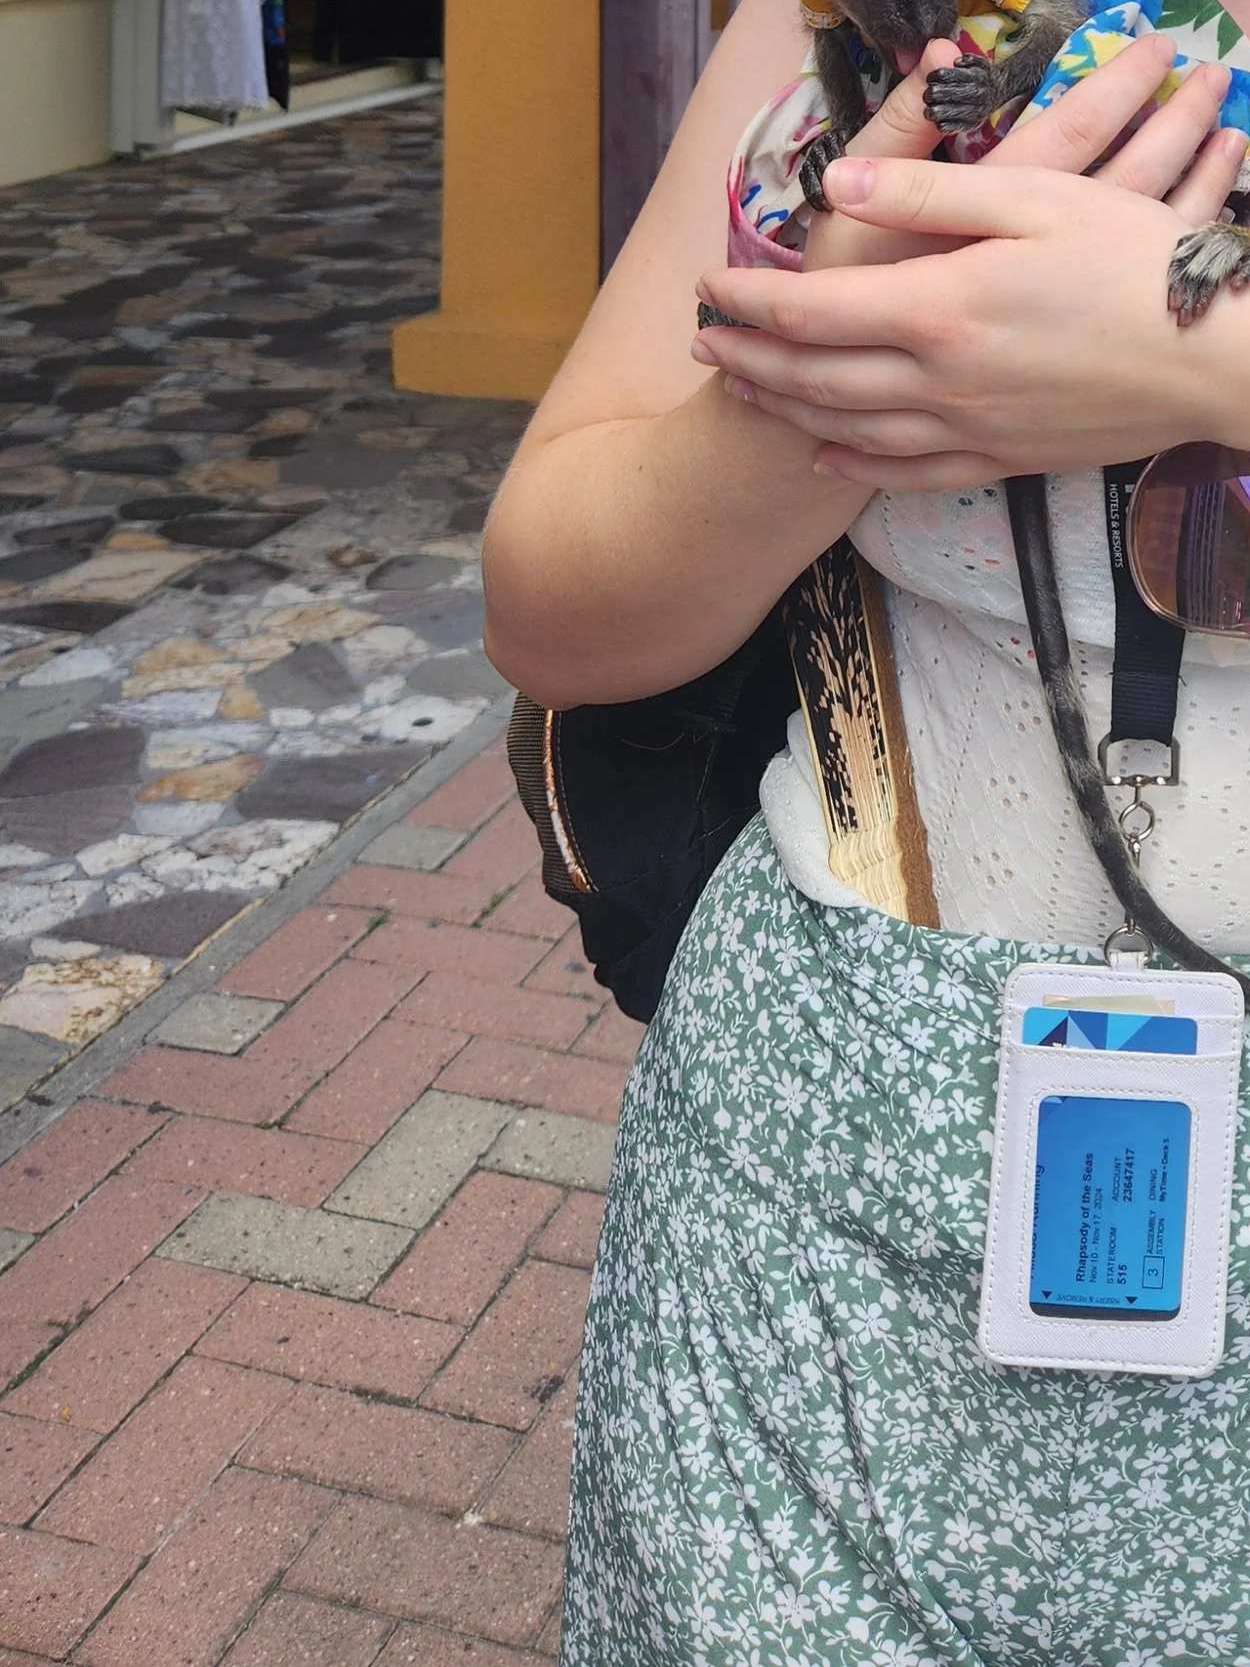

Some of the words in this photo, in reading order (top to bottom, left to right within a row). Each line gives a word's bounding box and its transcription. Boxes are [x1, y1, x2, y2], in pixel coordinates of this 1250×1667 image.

[1109, 483, 1120, 520] HOTELS
[1111, 520, 1120, 529] &
[1112, 529, 1124, 569] RESORTS
[1083, 1153, 1094, 1182] Seas
[1082, 1186, 1091, 1203] the
[1149, 1168, 1158, 1201] DINING
[1159, 1170, 1168, 1202] MyTime
[1082, 1205, 1090, 1219] of
[1107, 1227, 1117, 1285] STATEROOM
[1112, 1157, 1122, 1202] ACCOUNT
[1092, 1231, 1100, 1245] Nov
[1147, 1209, 1157, 1254] ASSEMBLY
[1156, 1218, 1165, 1255] STATION
[1076, 1221, 1091, 1282] Rhapsody
[1091, 1253, 1099, 1266] 10
[1148, 1268, 1158, 1277] 3
